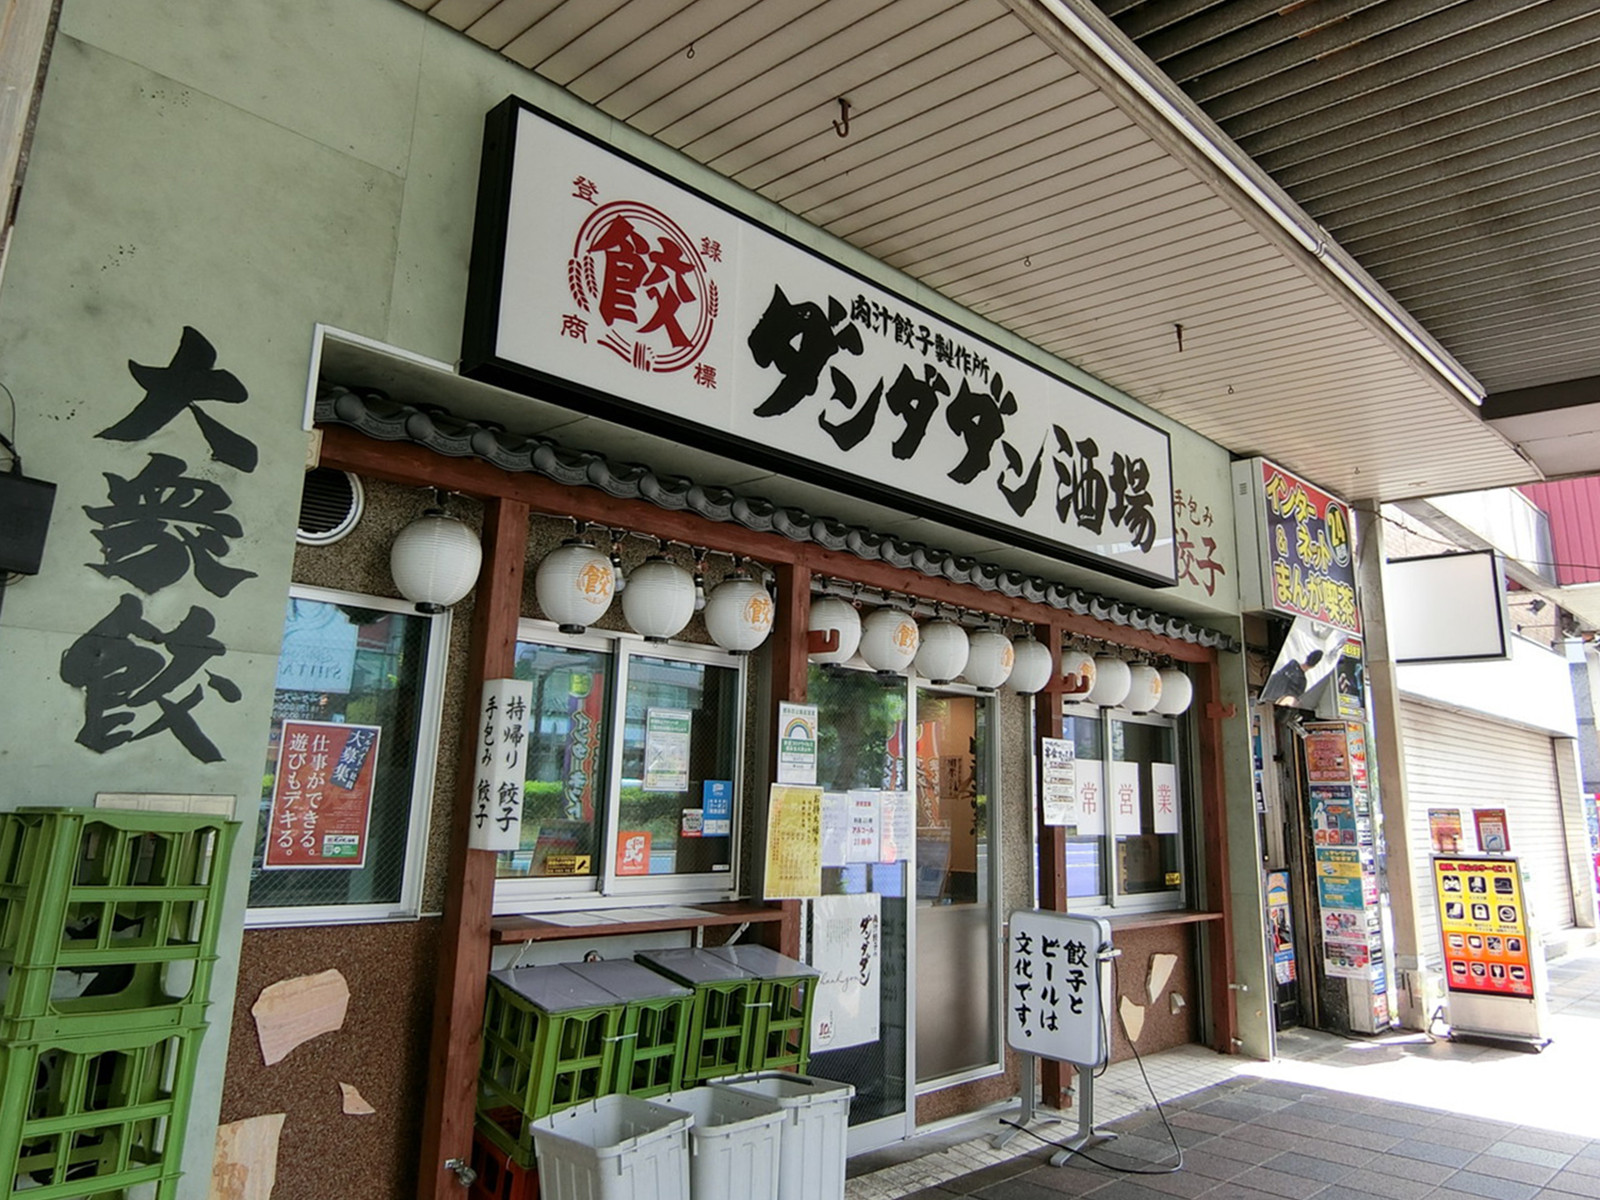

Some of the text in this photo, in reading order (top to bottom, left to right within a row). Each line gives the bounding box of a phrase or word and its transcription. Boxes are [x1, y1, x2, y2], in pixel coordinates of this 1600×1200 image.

[571, 175, 599, 206] 登
[586, 214, 697, 348] 餃
[560, 313, 589, 344] 商
[850, 294, 990, 385] 肉汁餃子製作所
[693, 362, 717, 390] 標
[1265, 472, 1317, 524] インター
[1327, 509, 1347, 547] 24
[277, 732, 308, 857] 遊びもデキる。
[299, 733, 330, 857] 仕事ができる。
[332, 730, 366, 782] 大募集
[475, 694, 498, 830] 手包み 餃子
[495, 695, 527, 833] 持帰り 餃子
[859, 914, 873, 987] ダンダダン
[1014, 931, 1034, 1038] 文化です。
[1040, 935, 1061, 1032] ビールは
[1063, 939, 1090, 1015] 餃子と
